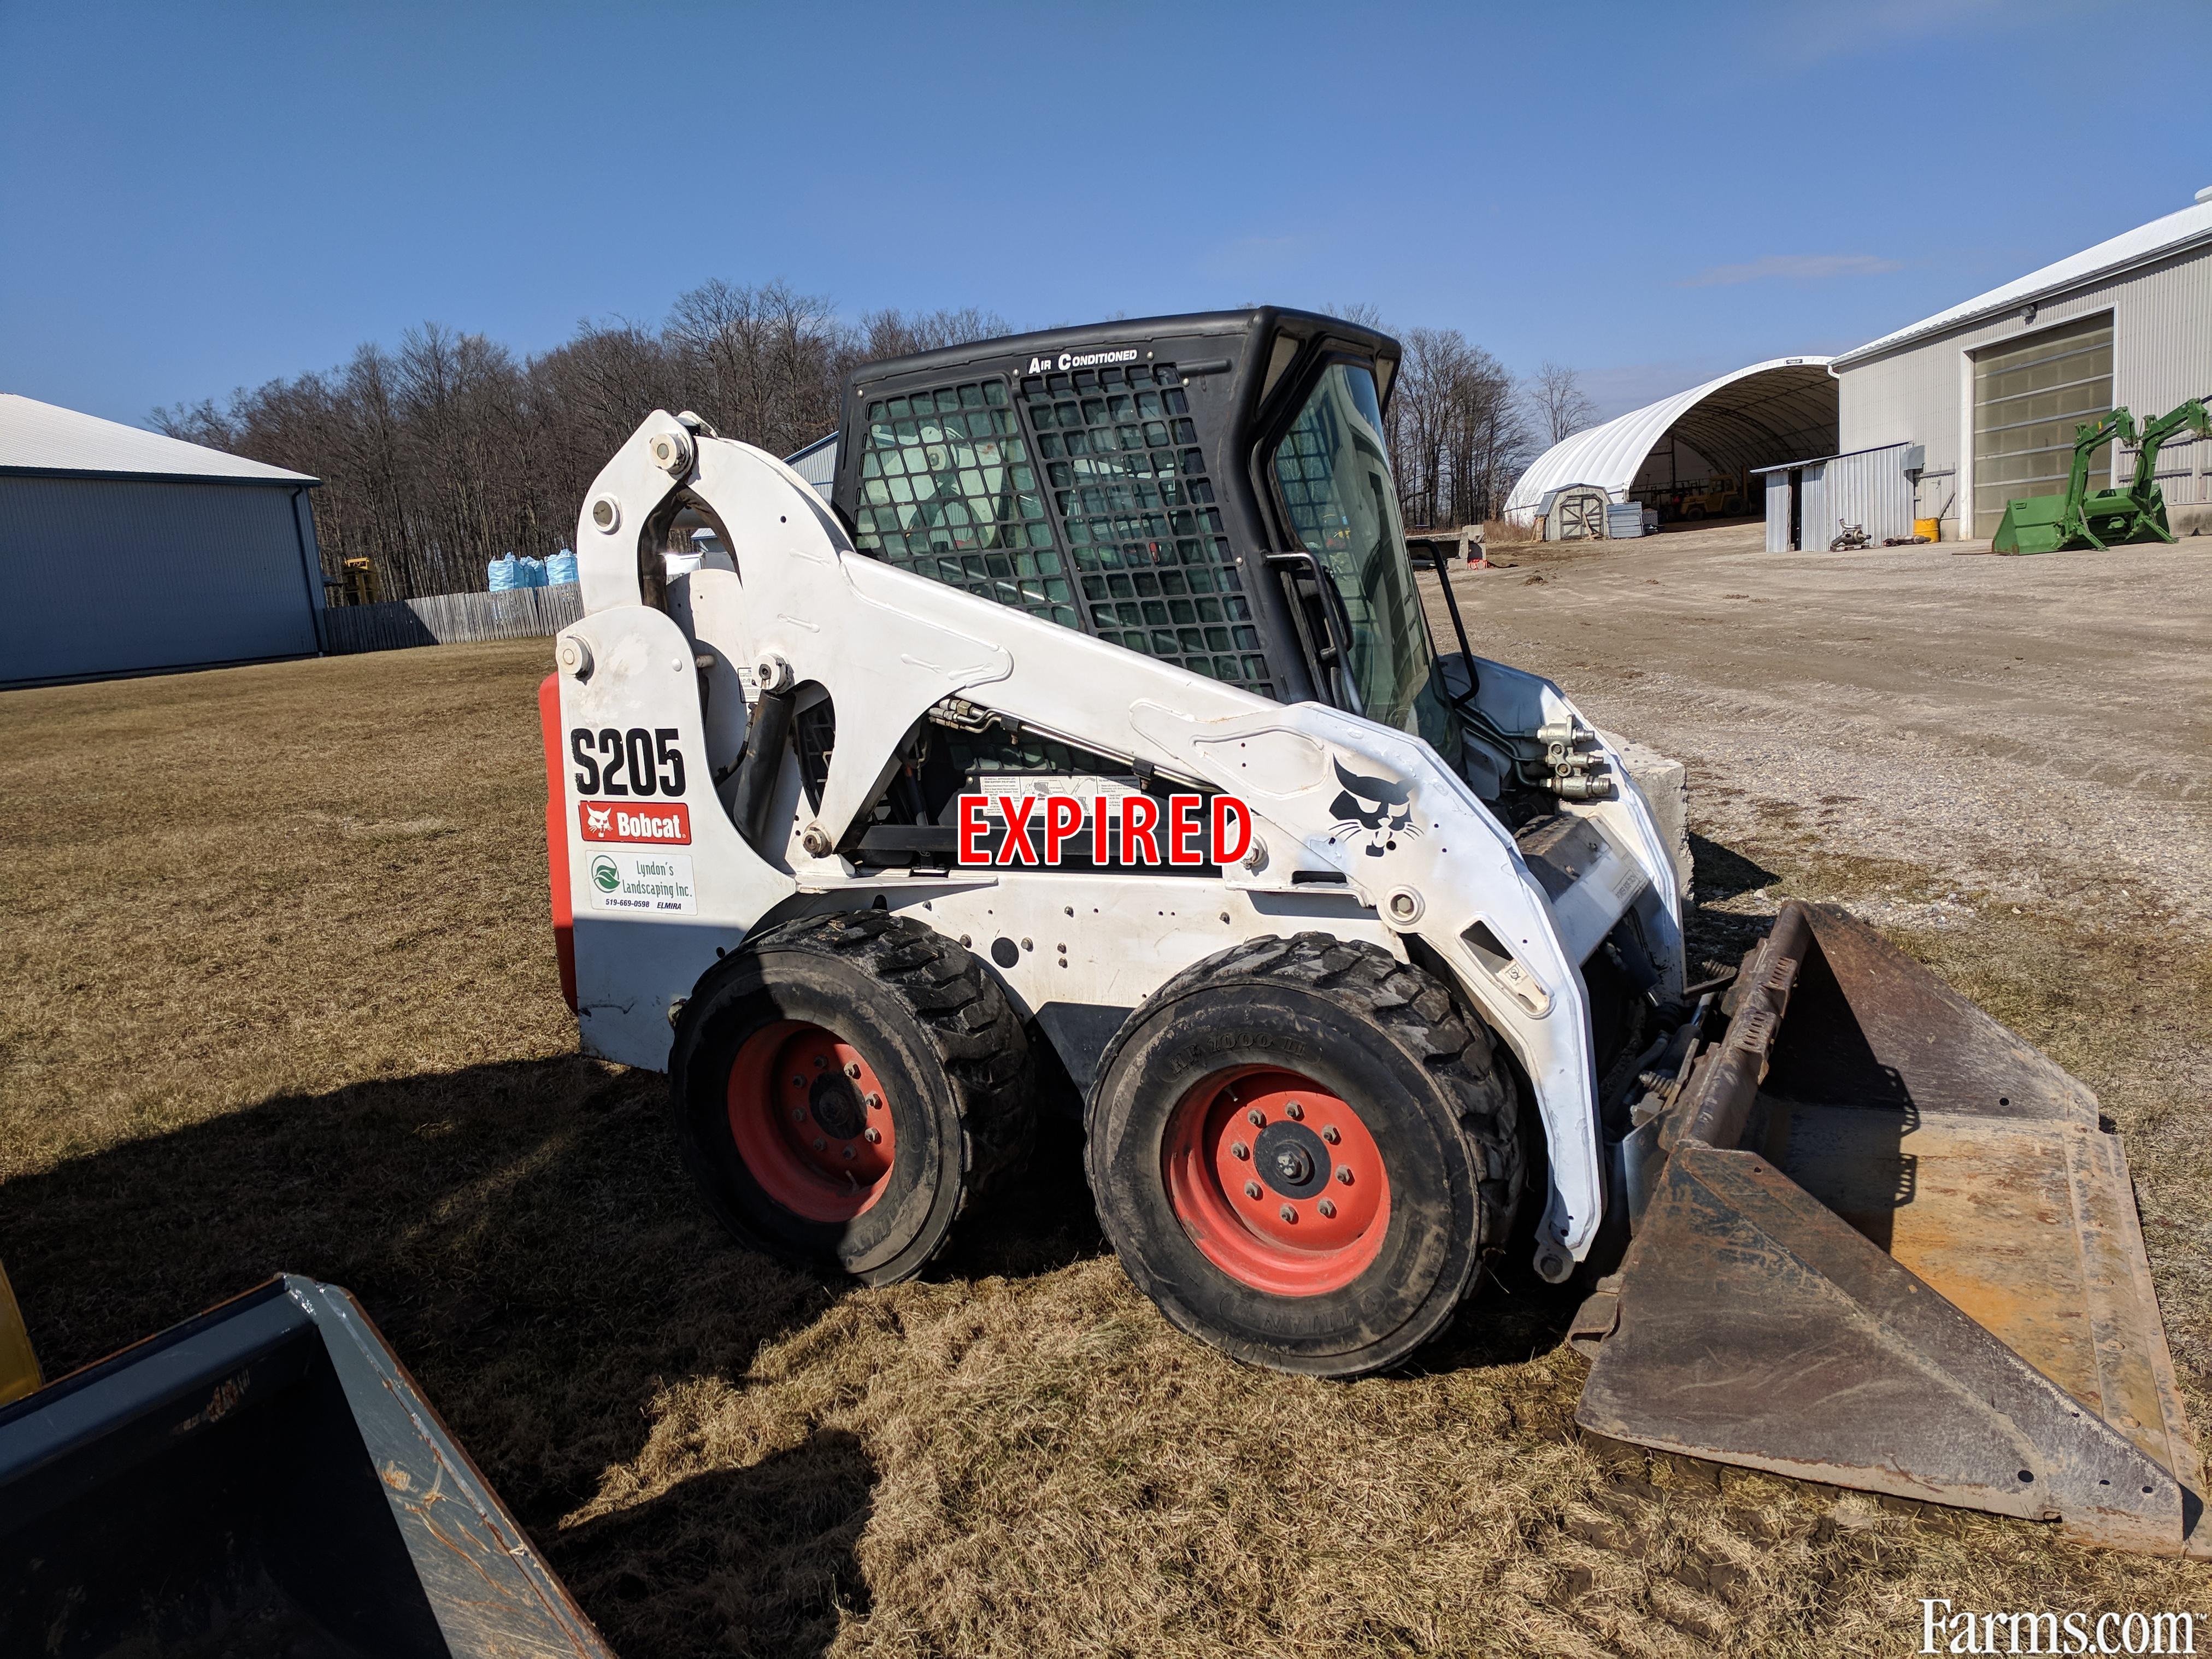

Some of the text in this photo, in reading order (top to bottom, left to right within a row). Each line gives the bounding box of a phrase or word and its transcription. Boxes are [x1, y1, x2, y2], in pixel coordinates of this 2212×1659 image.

[570, 728, 686, 797] S205
[616, 811, 681, 838] Bobcat
[636, 860, 674, 877] Lyndon's
[622, 879, 692, 898] Landscaping Inc.
[605, 898, 682, 910] 519-669-0598 ELMIRA
